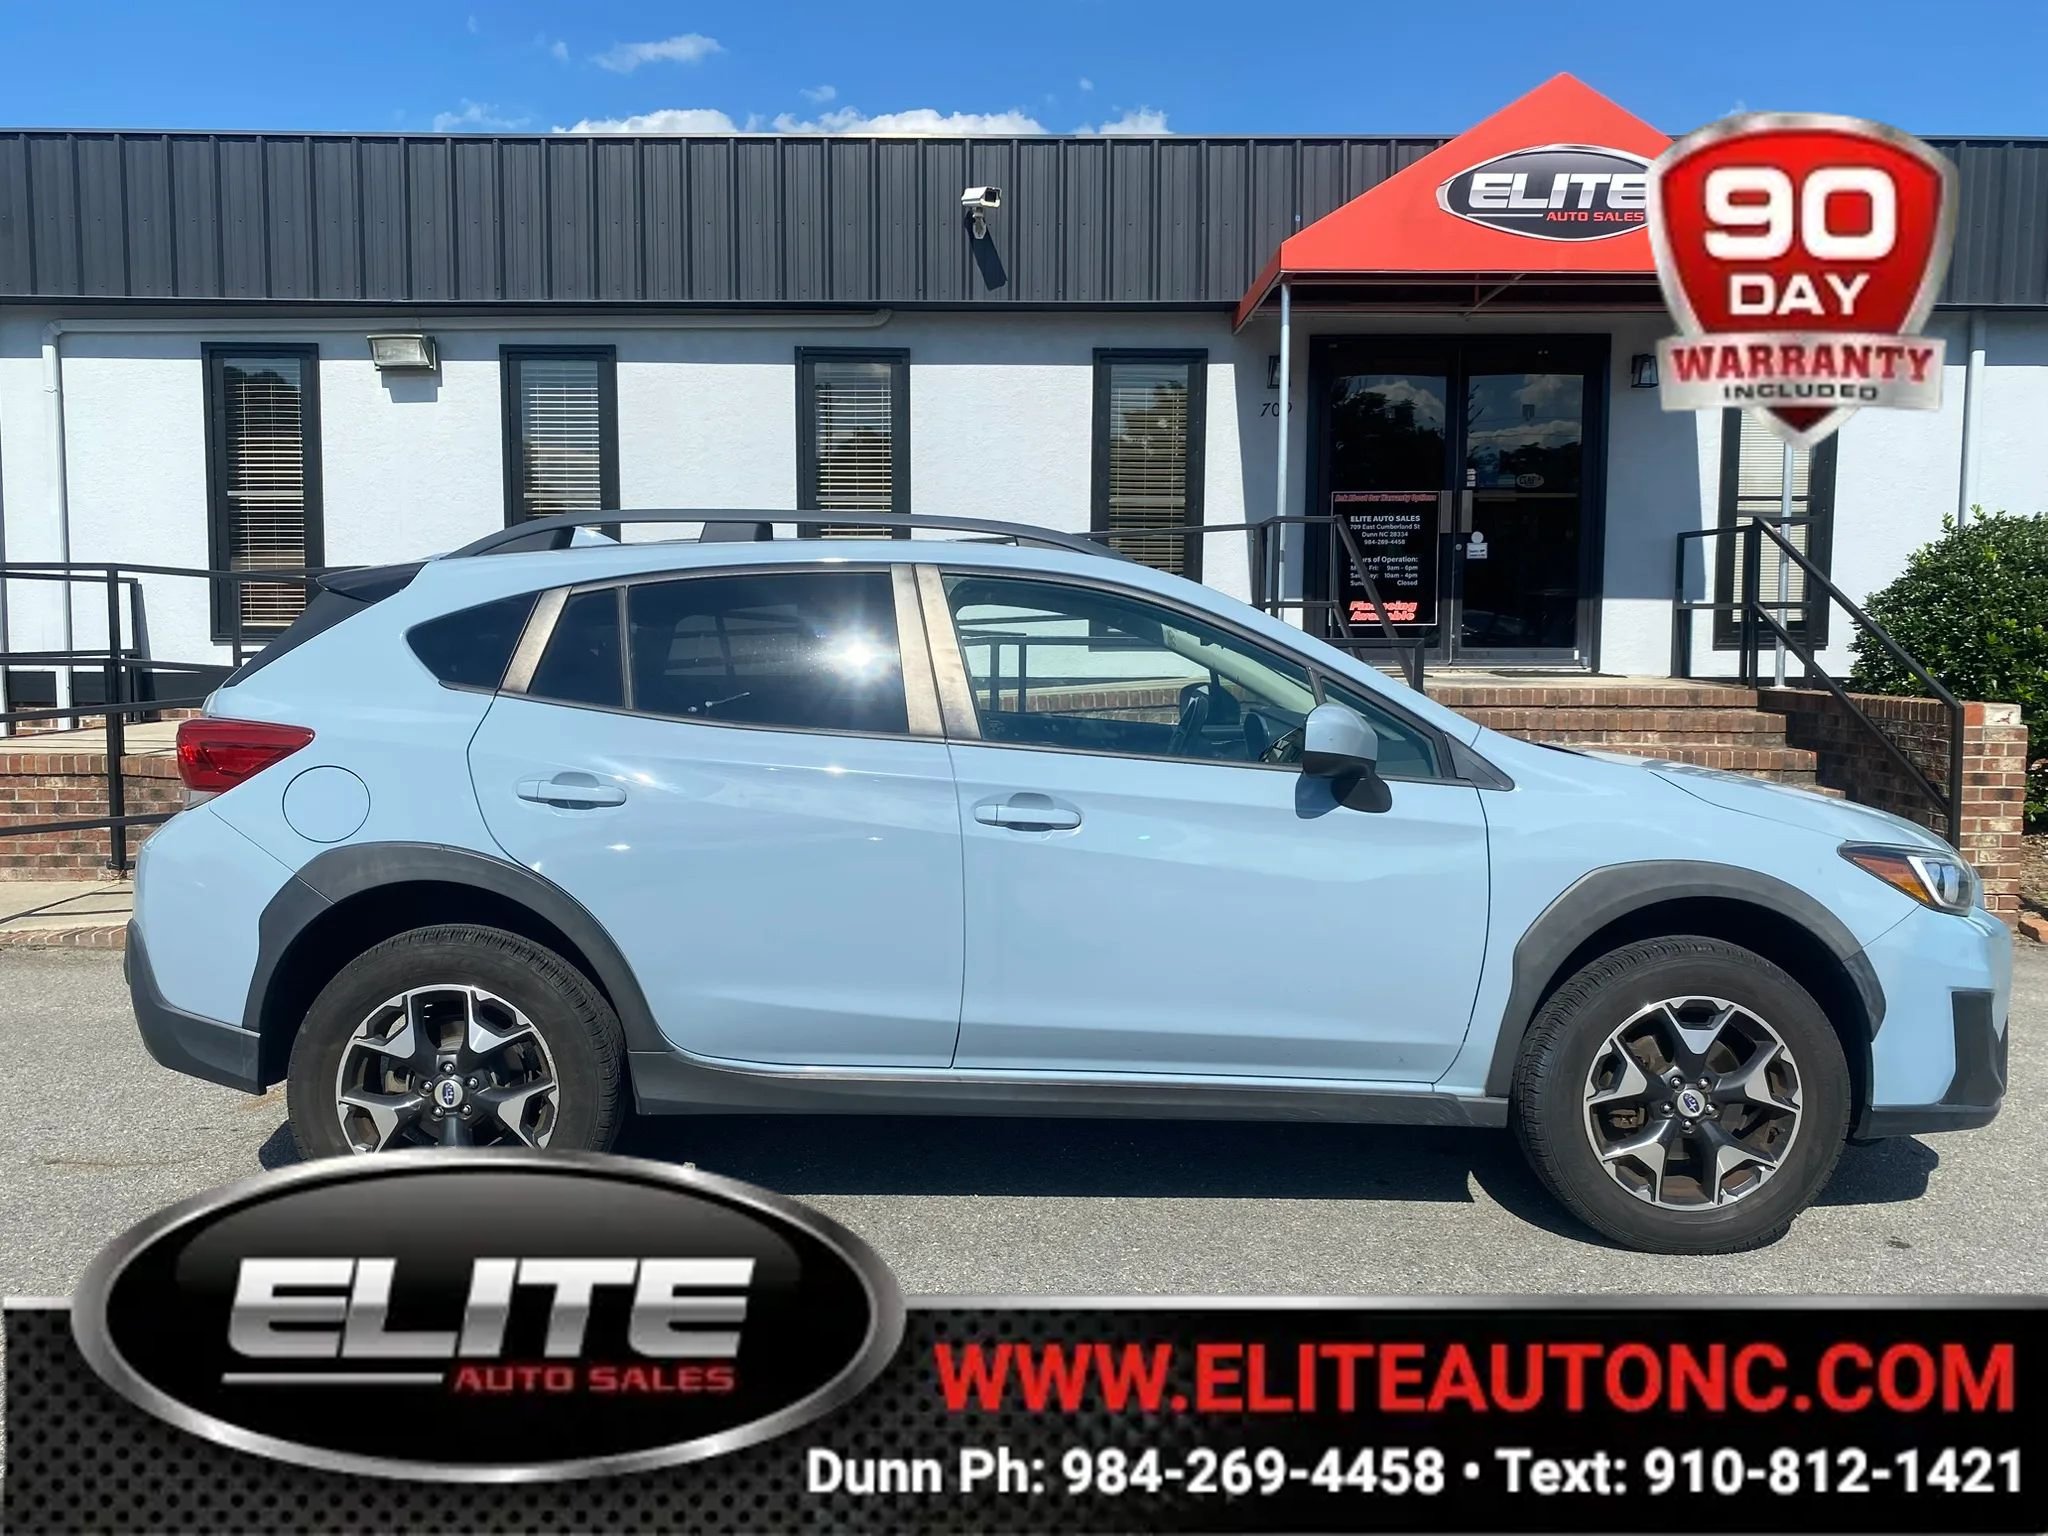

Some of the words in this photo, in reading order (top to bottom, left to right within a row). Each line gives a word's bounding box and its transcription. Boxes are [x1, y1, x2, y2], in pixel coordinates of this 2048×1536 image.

[1468, 173, 1646, 209] ELITE
[1546, 211, 1589, 222] AUTO
[1593, 211, 1645, 222] SALES
[1381, 556, 1419, 564] Operation:
